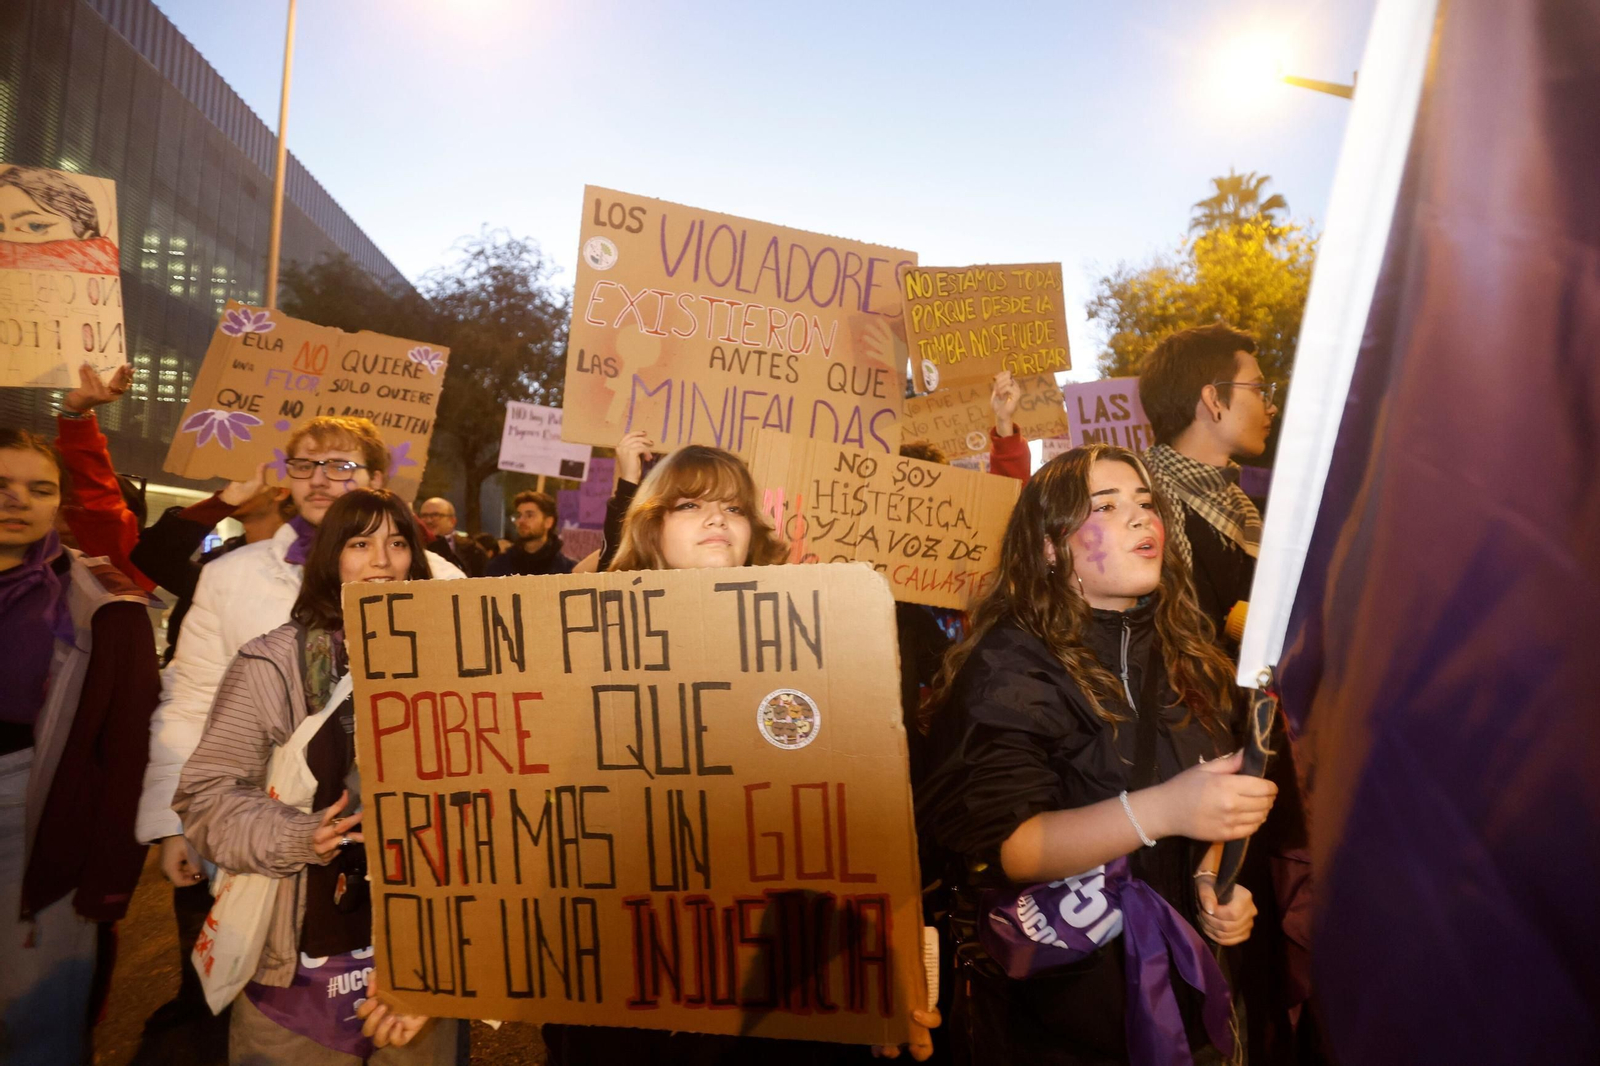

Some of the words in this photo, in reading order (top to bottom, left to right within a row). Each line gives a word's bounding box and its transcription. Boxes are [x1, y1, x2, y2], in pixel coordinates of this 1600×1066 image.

[593, 198, 647, 234] LOS
[660, 213, 914, 318] VIOLADORES
[905, 270, 933, 300] NO
[936, 268, 1007, 297] ESTAMOS
[1011, 269, 1063, 291] TODAS
[585, 280, 838, 359] EXISTIERON
[911, 298, 976, 333] PORQUE
[981, 295, 1033, 321] DESDE
[1036, 295, 1054, 314] LA
[242, 332, 284, 352] ELLA
[293, 341, 329, 374] NO
[341, 350, 425, 379] QUIERE
[917, 330, 968, 366] TUMBA
[969, 327, 991, 359] NO
[991, 323, 1009, 353] SE
[1011, 319, 1055, 350] PUEDE
[328, 378, 371, 394] SOLO
[376, 384, 434, 406] QUIERE
[709, 346, 799, 384] ANTES
[827, 362, 889, 399] QUE
[217, 388, 264, 412] QUE
[279, 399, 304, 419] NO
[576, 348, 619, 378] LAS
[625, 373, 897, 454] MINIFALDAS
[926, 394, 954, 413] FUE
[959, 388, 980, 404] LA
[1077, 393, 1132, 425] LAS
[901, 421, 928, 441] NO
[933, 414, 961, 431] FUE
[966, 405, 989, 423] EL
[834, 451, 878, 479] NO
[892, 459, 942, 488] SOY
[834, 524, 880, 553] LA
[888, 529, 942, 561] VOZ
[948, 537, 987, 562] DE
[892, 564, 994, 598] CALLASTE
[359, 592, 419, 679] ES
[451, 592, 526, 678] UN
[559, 576, 672, 674] PAÍS
[714, 579, 824, 673] TAN
[369, 690, 550, 783] POBRE
[591, 681, 734, 780] QUE
[373, 788, 498, 887] GRITA
[509, 784, 617, 890] MAS
[643, 785, 712, 892] UN
[743, 781, 878, 884] GOL
[384, 892, 478, 999] QUE
[499, 893, 604, 1005] UNA
[622, 887, 898, 1019] INJUSTICIA
